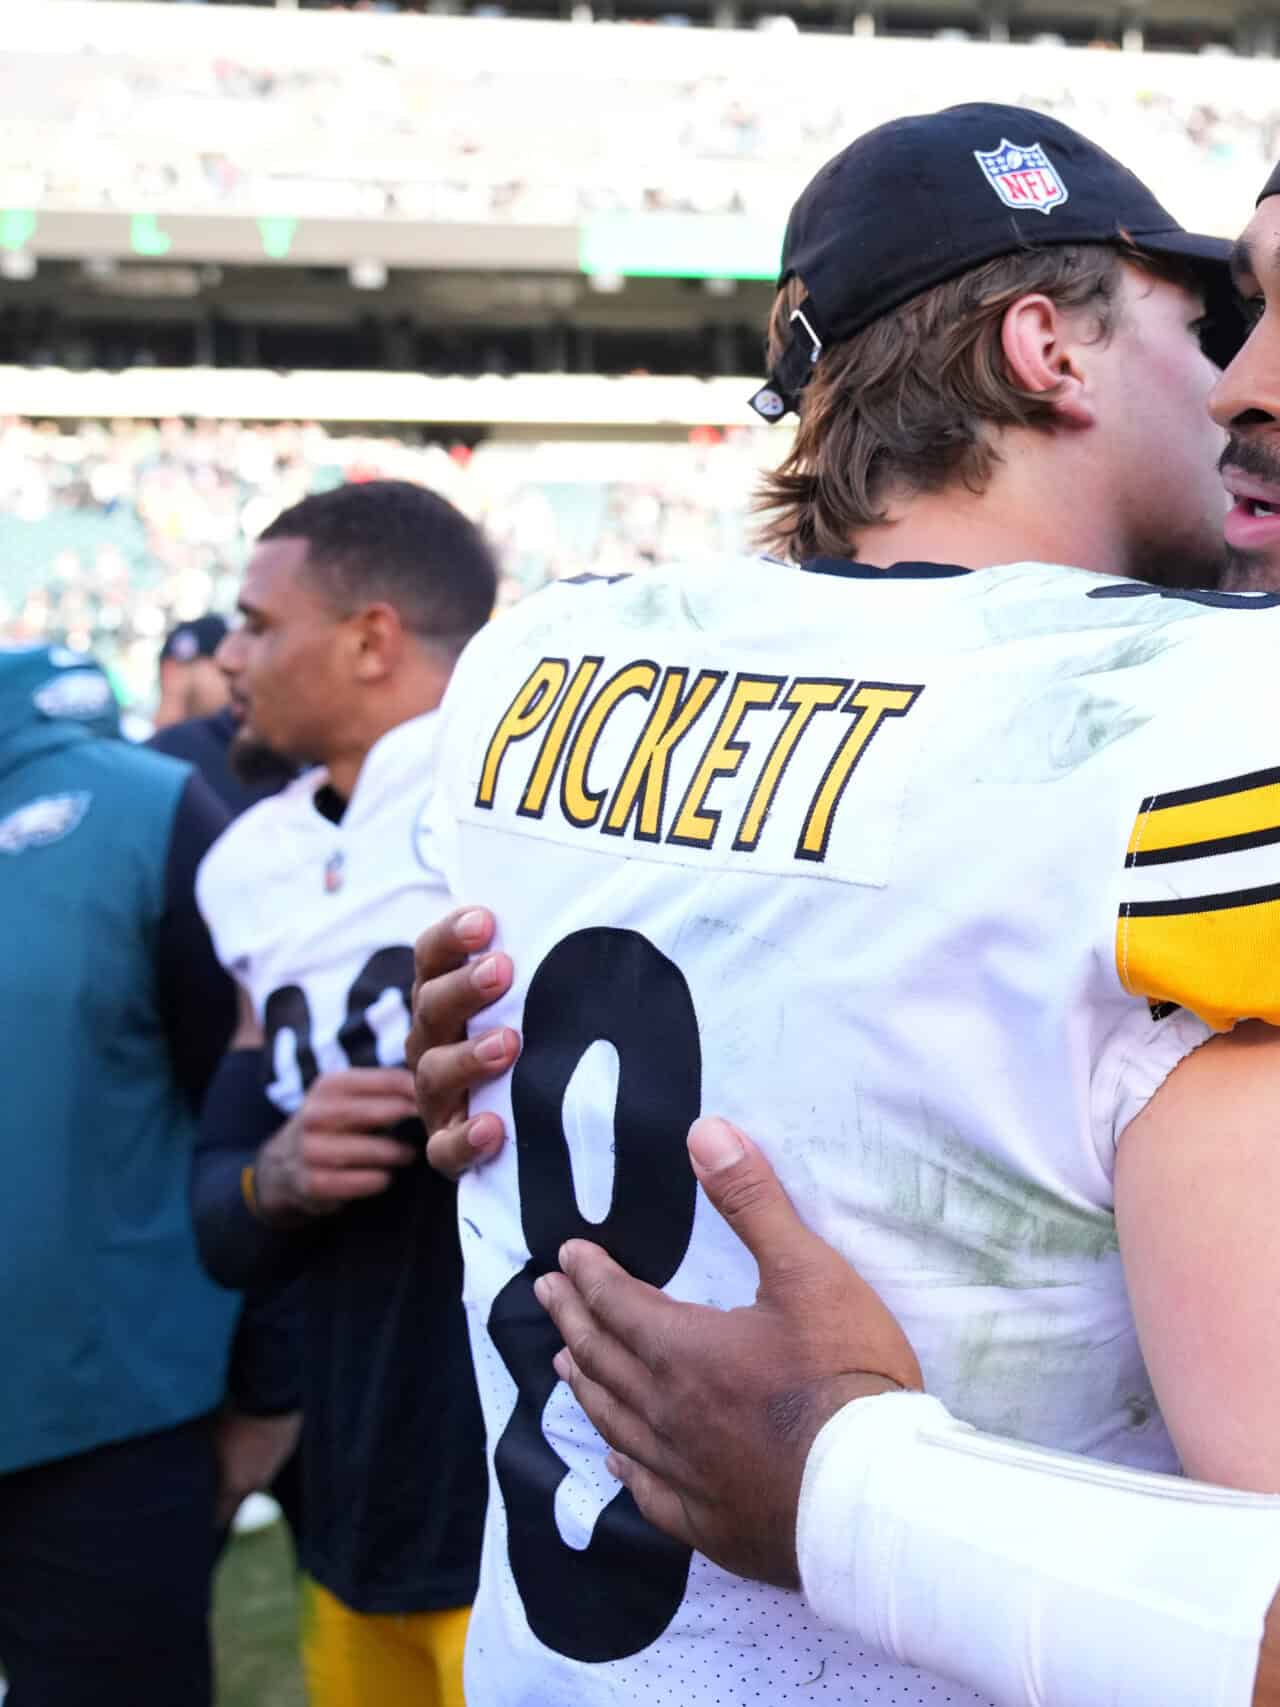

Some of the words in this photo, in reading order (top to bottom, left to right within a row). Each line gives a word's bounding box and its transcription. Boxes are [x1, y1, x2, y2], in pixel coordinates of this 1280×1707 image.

[999, 169, 1058, 202] NFL
[474, 655, 926, 863] PICKETT
[487, 926, 701, 1663] 8
